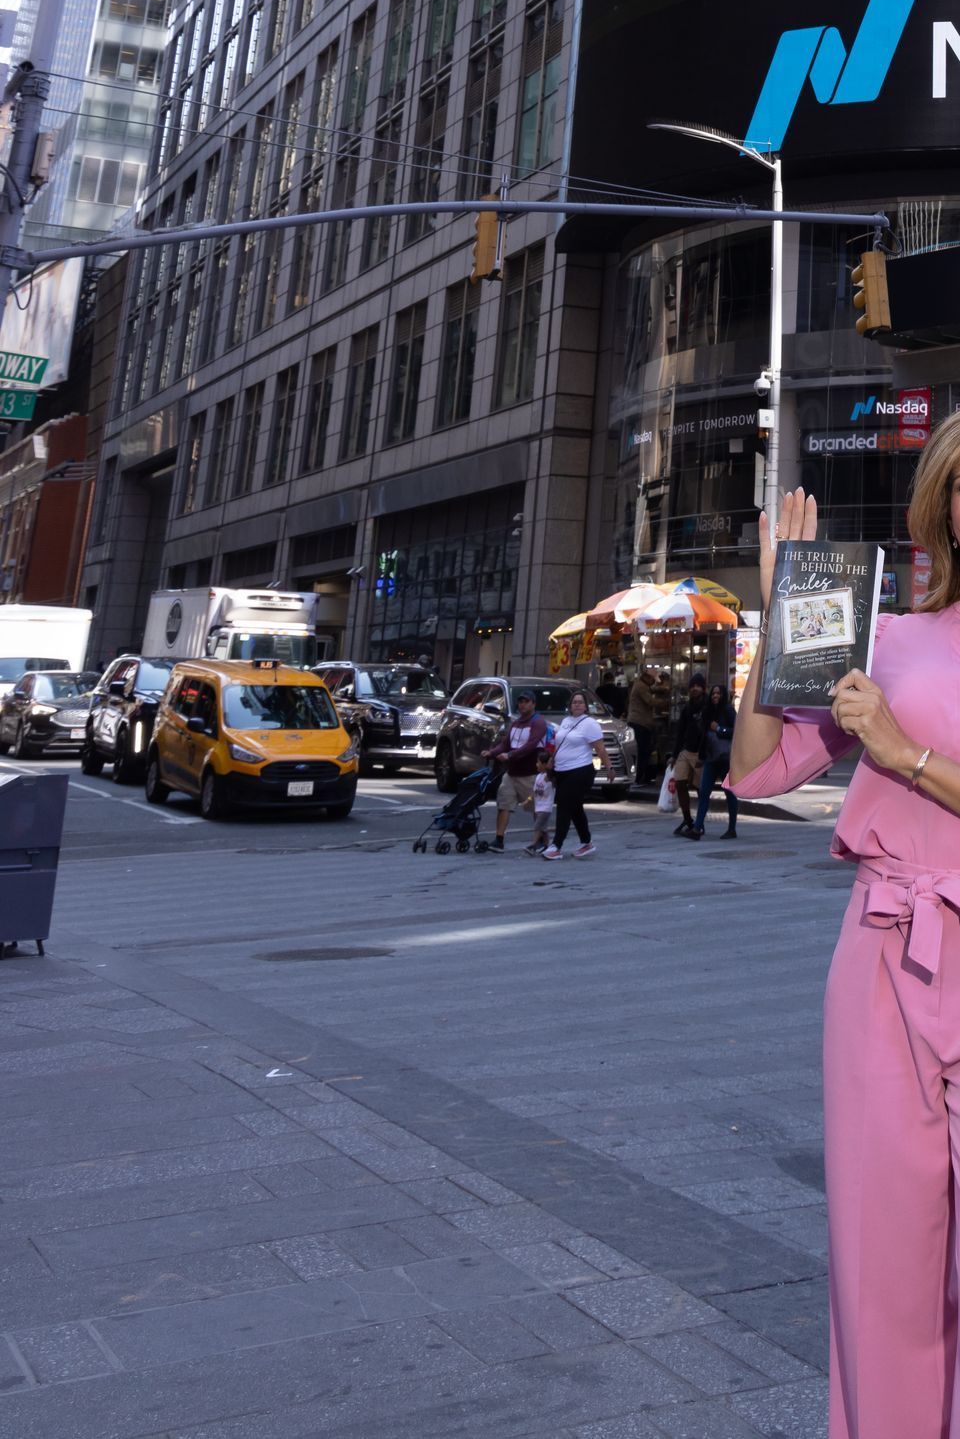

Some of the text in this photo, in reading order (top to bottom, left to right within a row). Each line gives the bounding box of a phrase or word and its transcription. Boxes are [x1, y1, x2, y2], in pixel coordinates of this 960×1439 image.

[876, 400, 928, 416] Nasdaq
[700, 414, 756, 432] TOMORROW
[783, 551, 844, 563] THE TRUTH
[800, 562, 868, 576] BEHIND THE
[777, 572, 833, 598] Smiles
[768, 677, 822, 693] Mélissa-Sue
